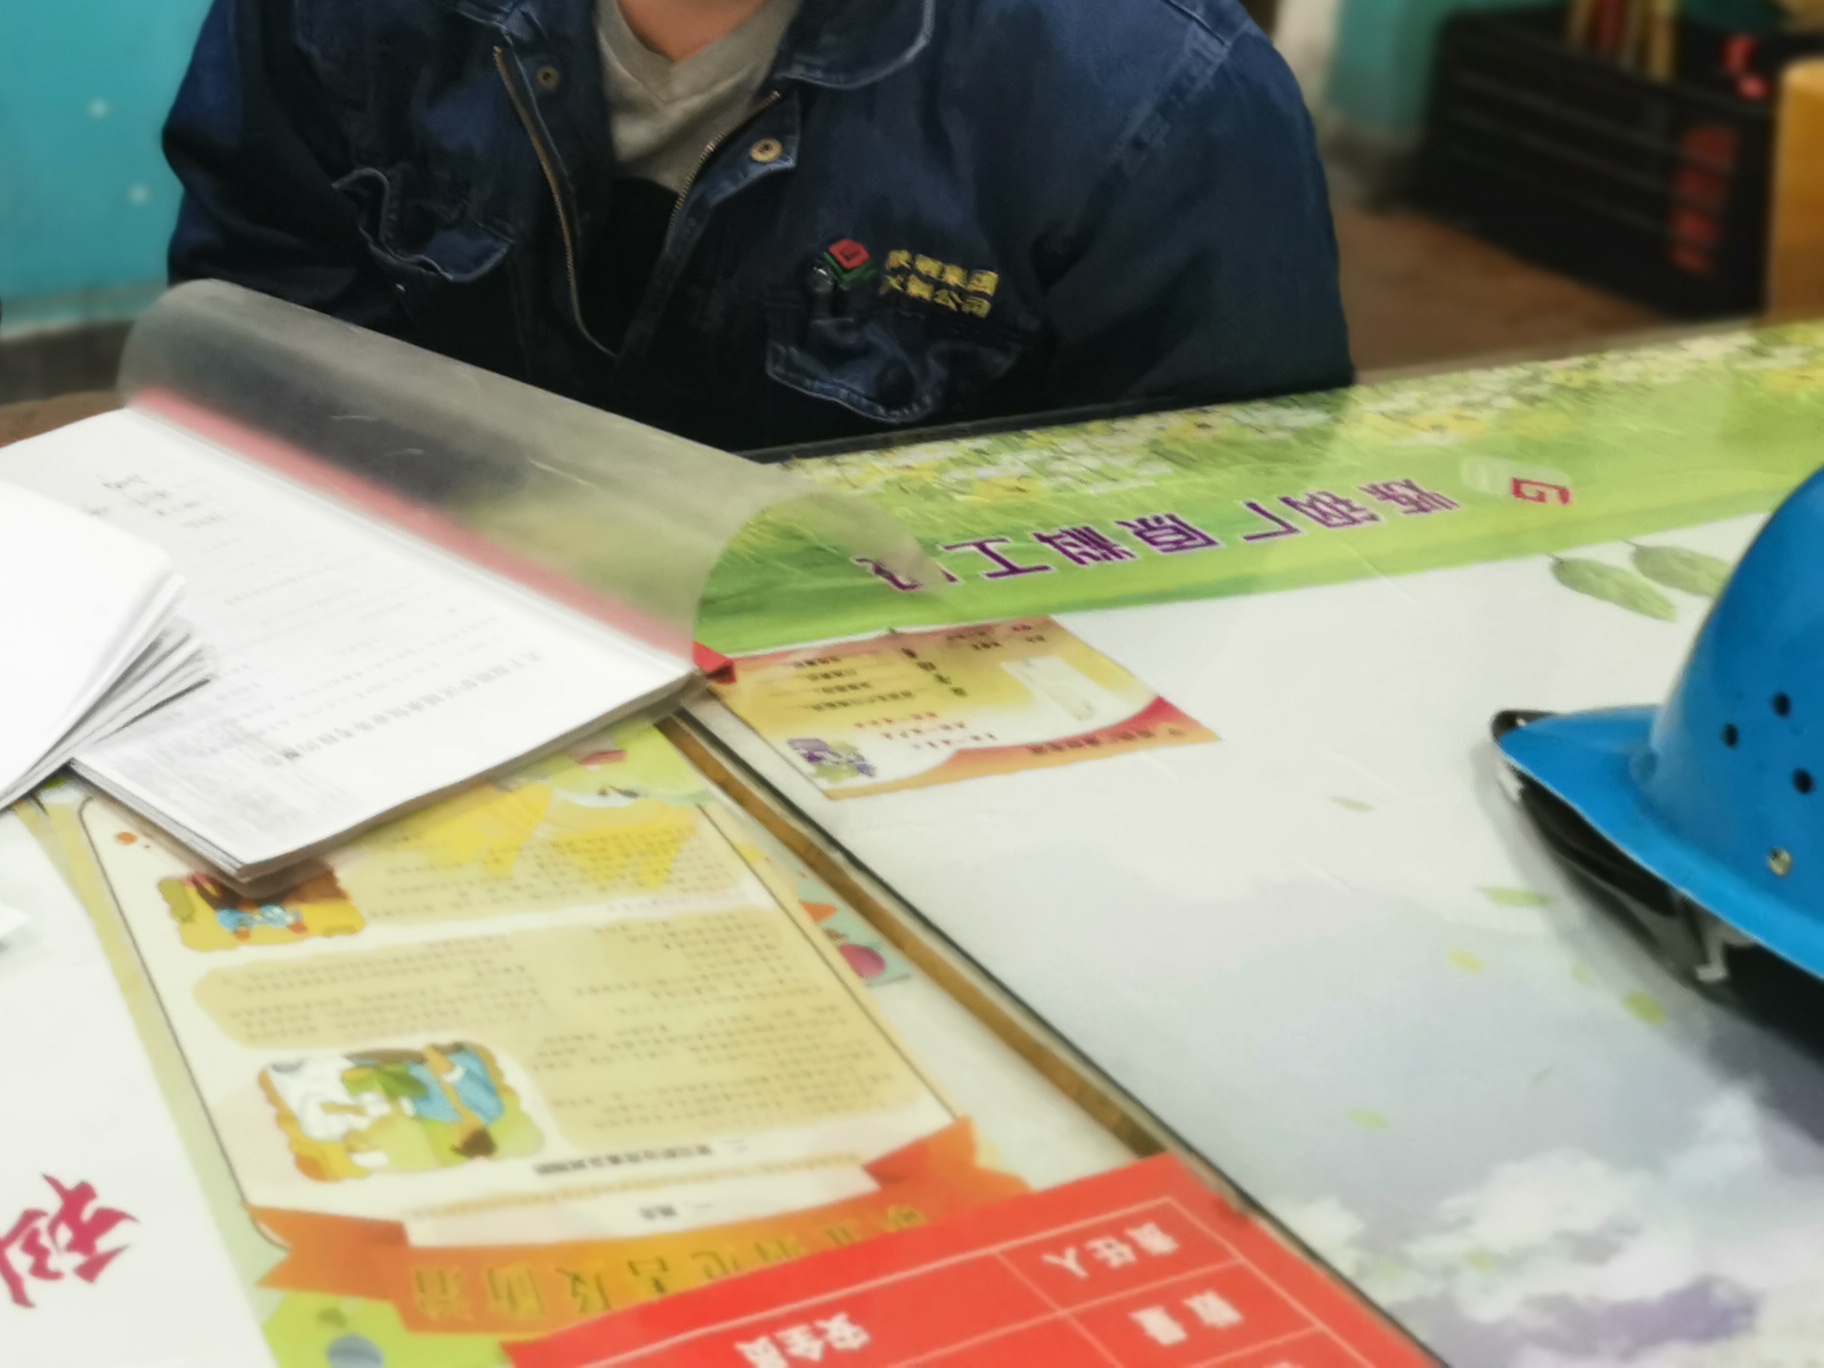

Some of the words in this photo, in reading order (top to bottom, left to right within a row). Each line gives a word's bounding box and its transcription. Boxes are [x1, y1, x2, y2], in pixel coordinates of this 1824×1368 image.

[1042, 1220, 1180, 1280] 责任人
[1128, 1287, 1244, 1347] 数量
